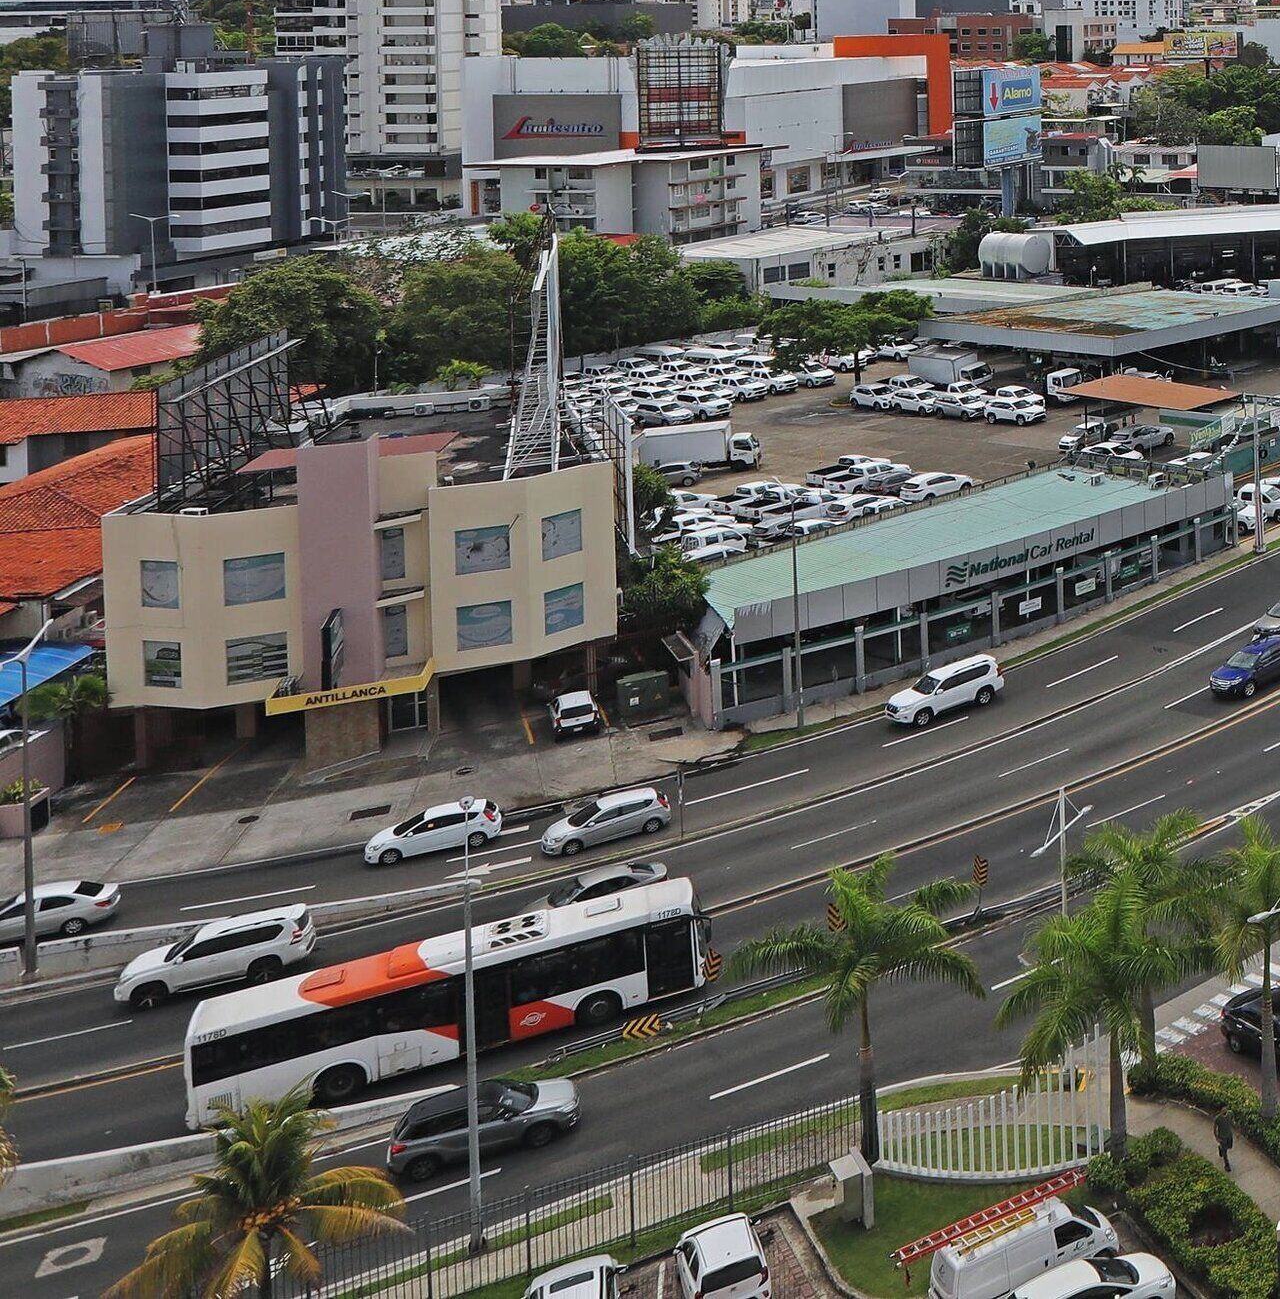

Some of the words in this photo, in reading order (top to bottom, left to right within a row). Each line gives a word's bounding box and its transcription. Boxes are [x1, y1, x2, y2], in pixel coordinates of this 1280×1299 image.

[1003, 87, 1032, 101] Alamo
[969, 549, 1030, 578] National
[1030, 543, 1054, 560] Car
[1055, 528, 1095, 552] Rental
[305, 686, 386, 706] ANTILLANCA
[657, 907, 682, 919] 1178D
[197, 1028, 227, 1043] 1178D
